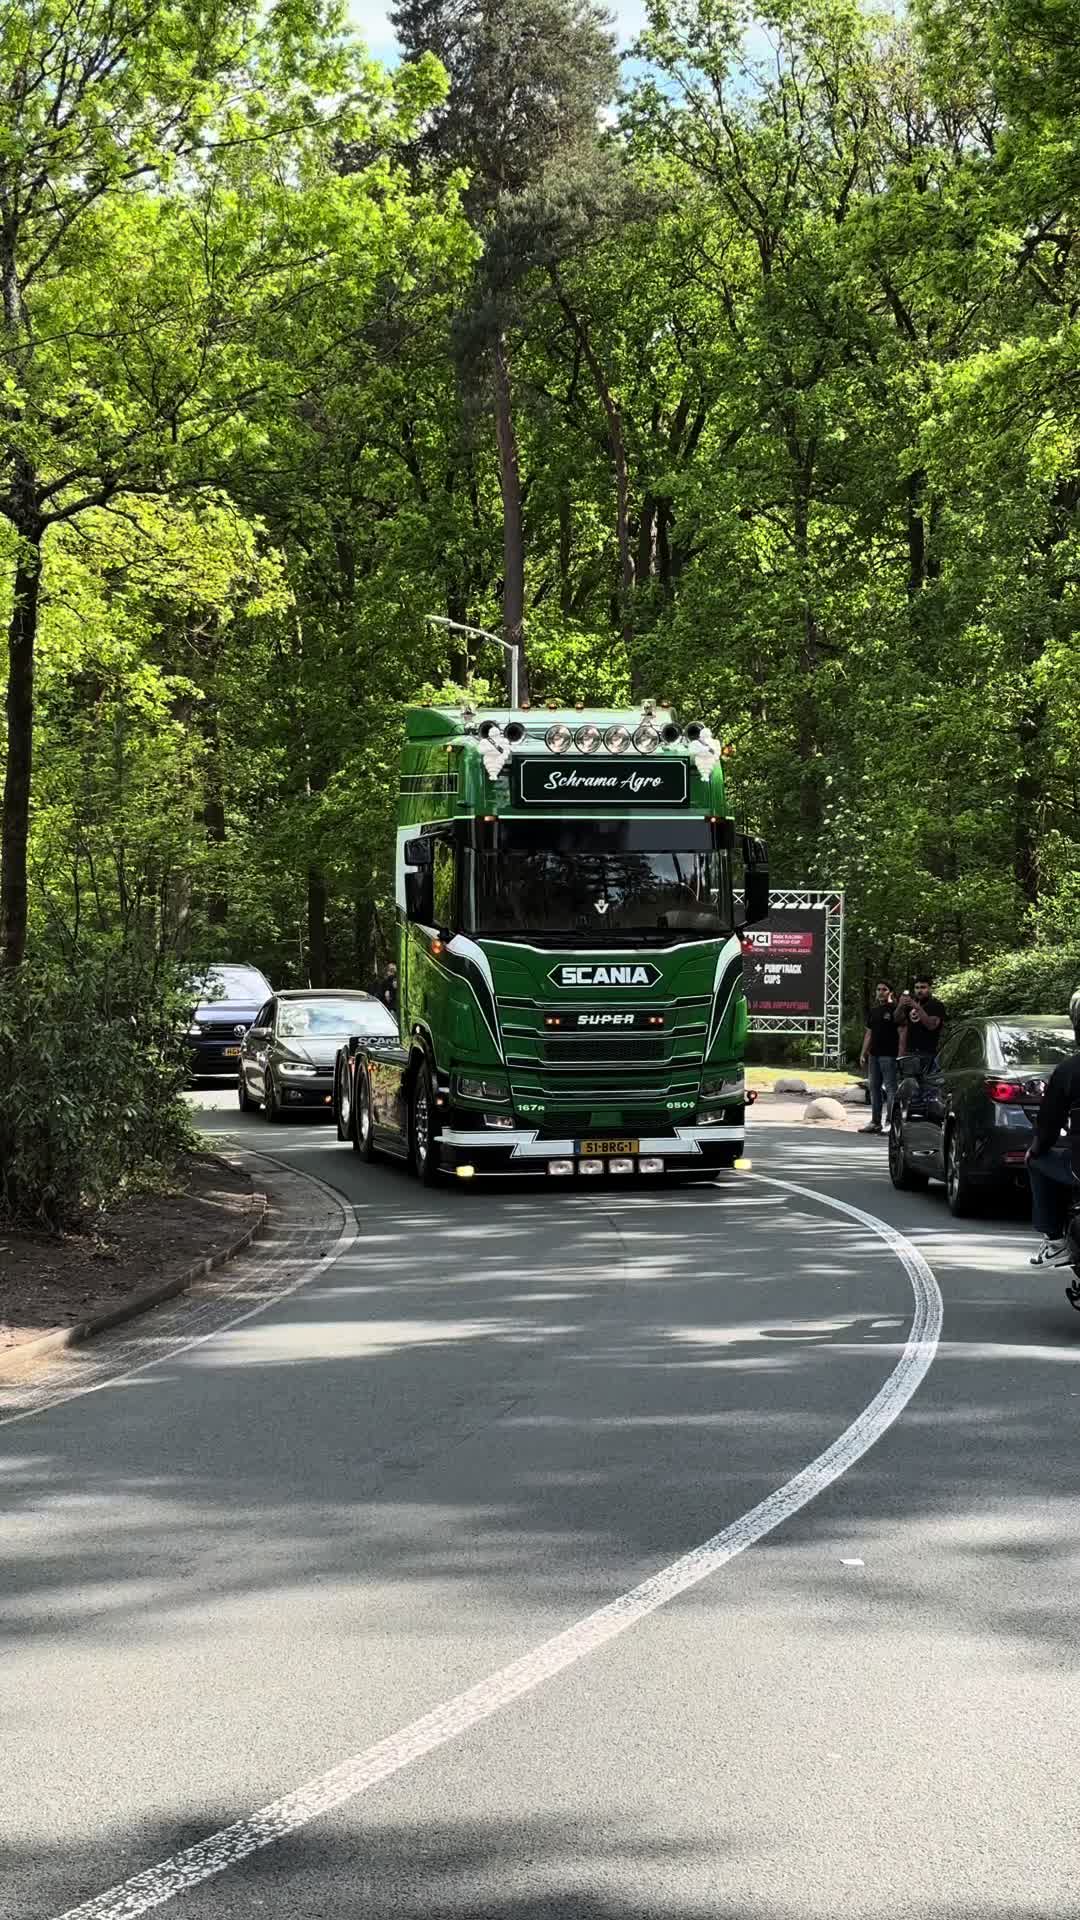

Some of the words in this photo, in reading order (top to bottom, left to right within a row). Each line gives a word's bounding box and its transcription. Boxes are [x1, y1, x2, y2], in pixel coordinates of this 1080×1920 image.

[543, 769, 618, 790] Schrama
[619, 771, 664, 793] Agro
[764, 964, 802, 974] PUMPTRACK
[561, 966, 649, 984] SCANIA
[763, 974, 780, 984] CUPS
[577, 1014, 635, 1025] SUPER
[357, 1036, 400, 1046] SCANI
